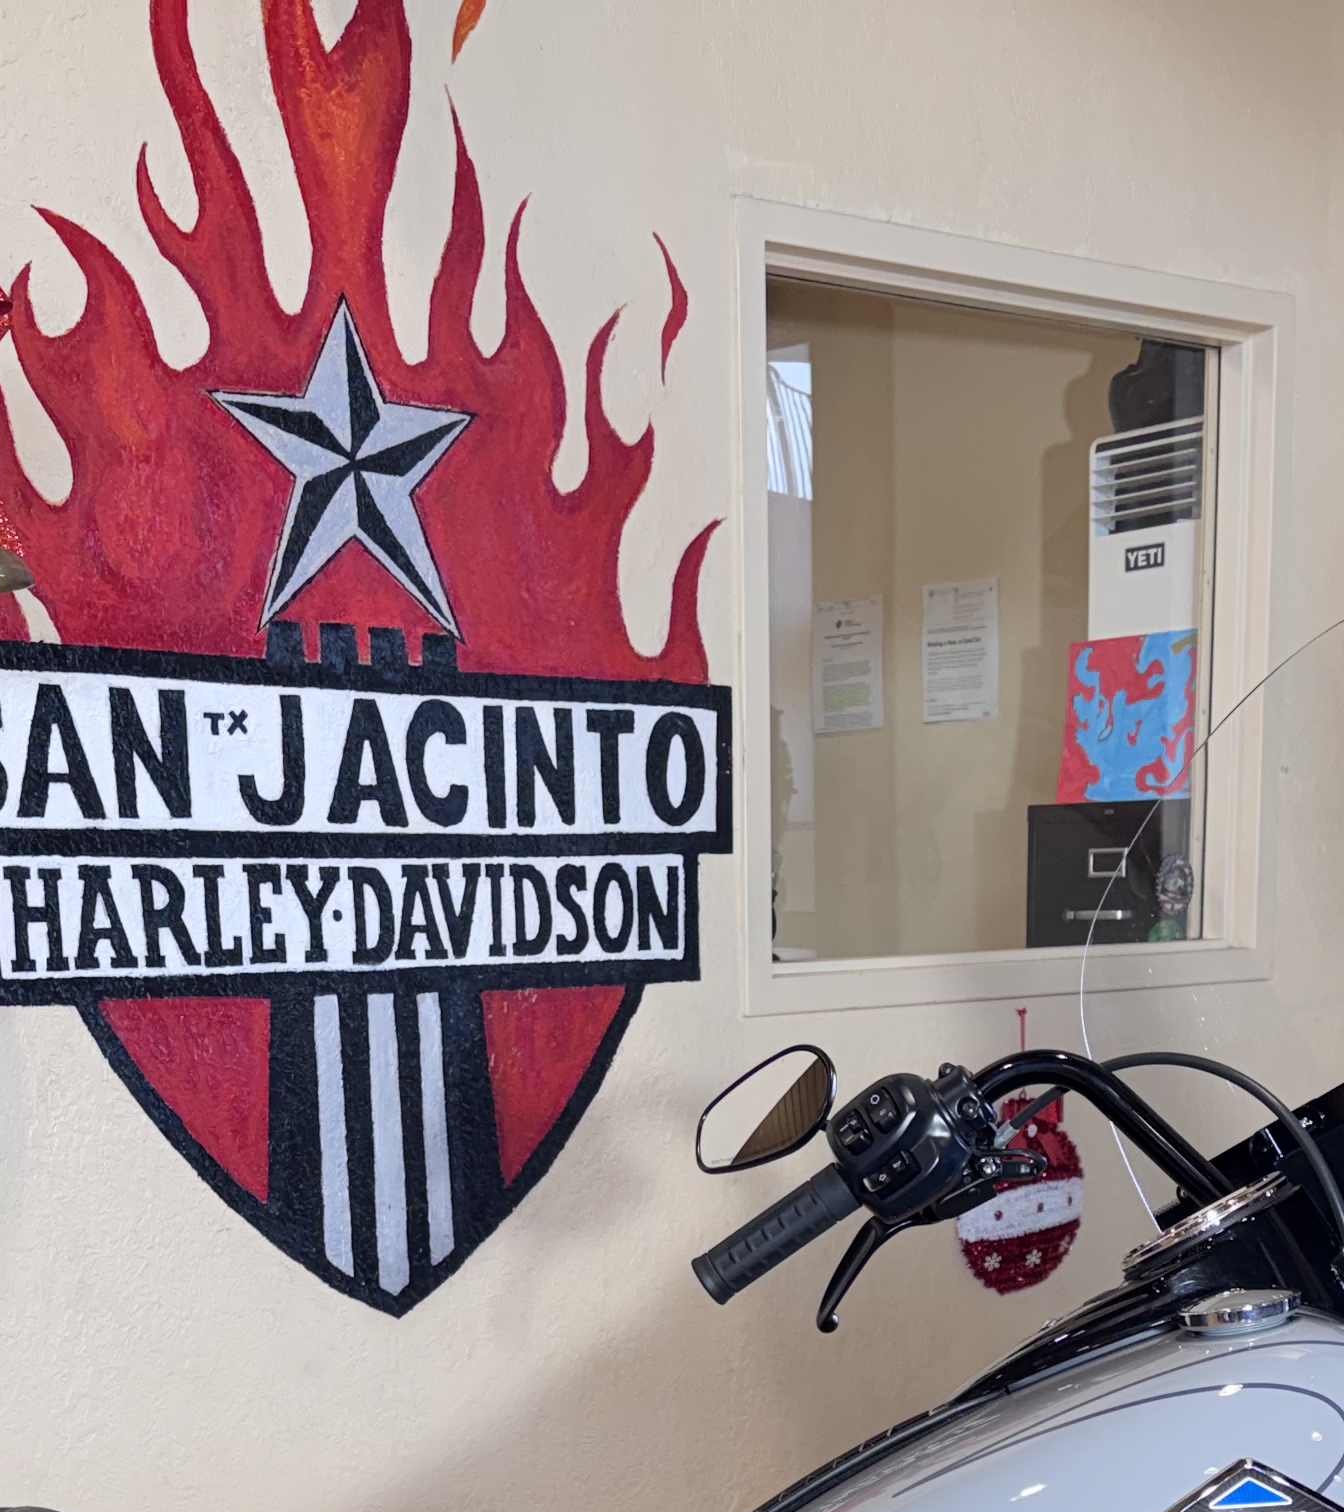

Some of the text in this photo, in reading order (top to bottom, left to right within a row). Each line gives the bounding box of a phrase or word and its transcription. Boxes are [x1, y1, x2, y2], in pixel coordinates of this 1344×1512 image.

[1126, 546, 1162, 569] YETI
[203, 709, 248, 736] TX
[238, 694, 707, 829] JACINTO
